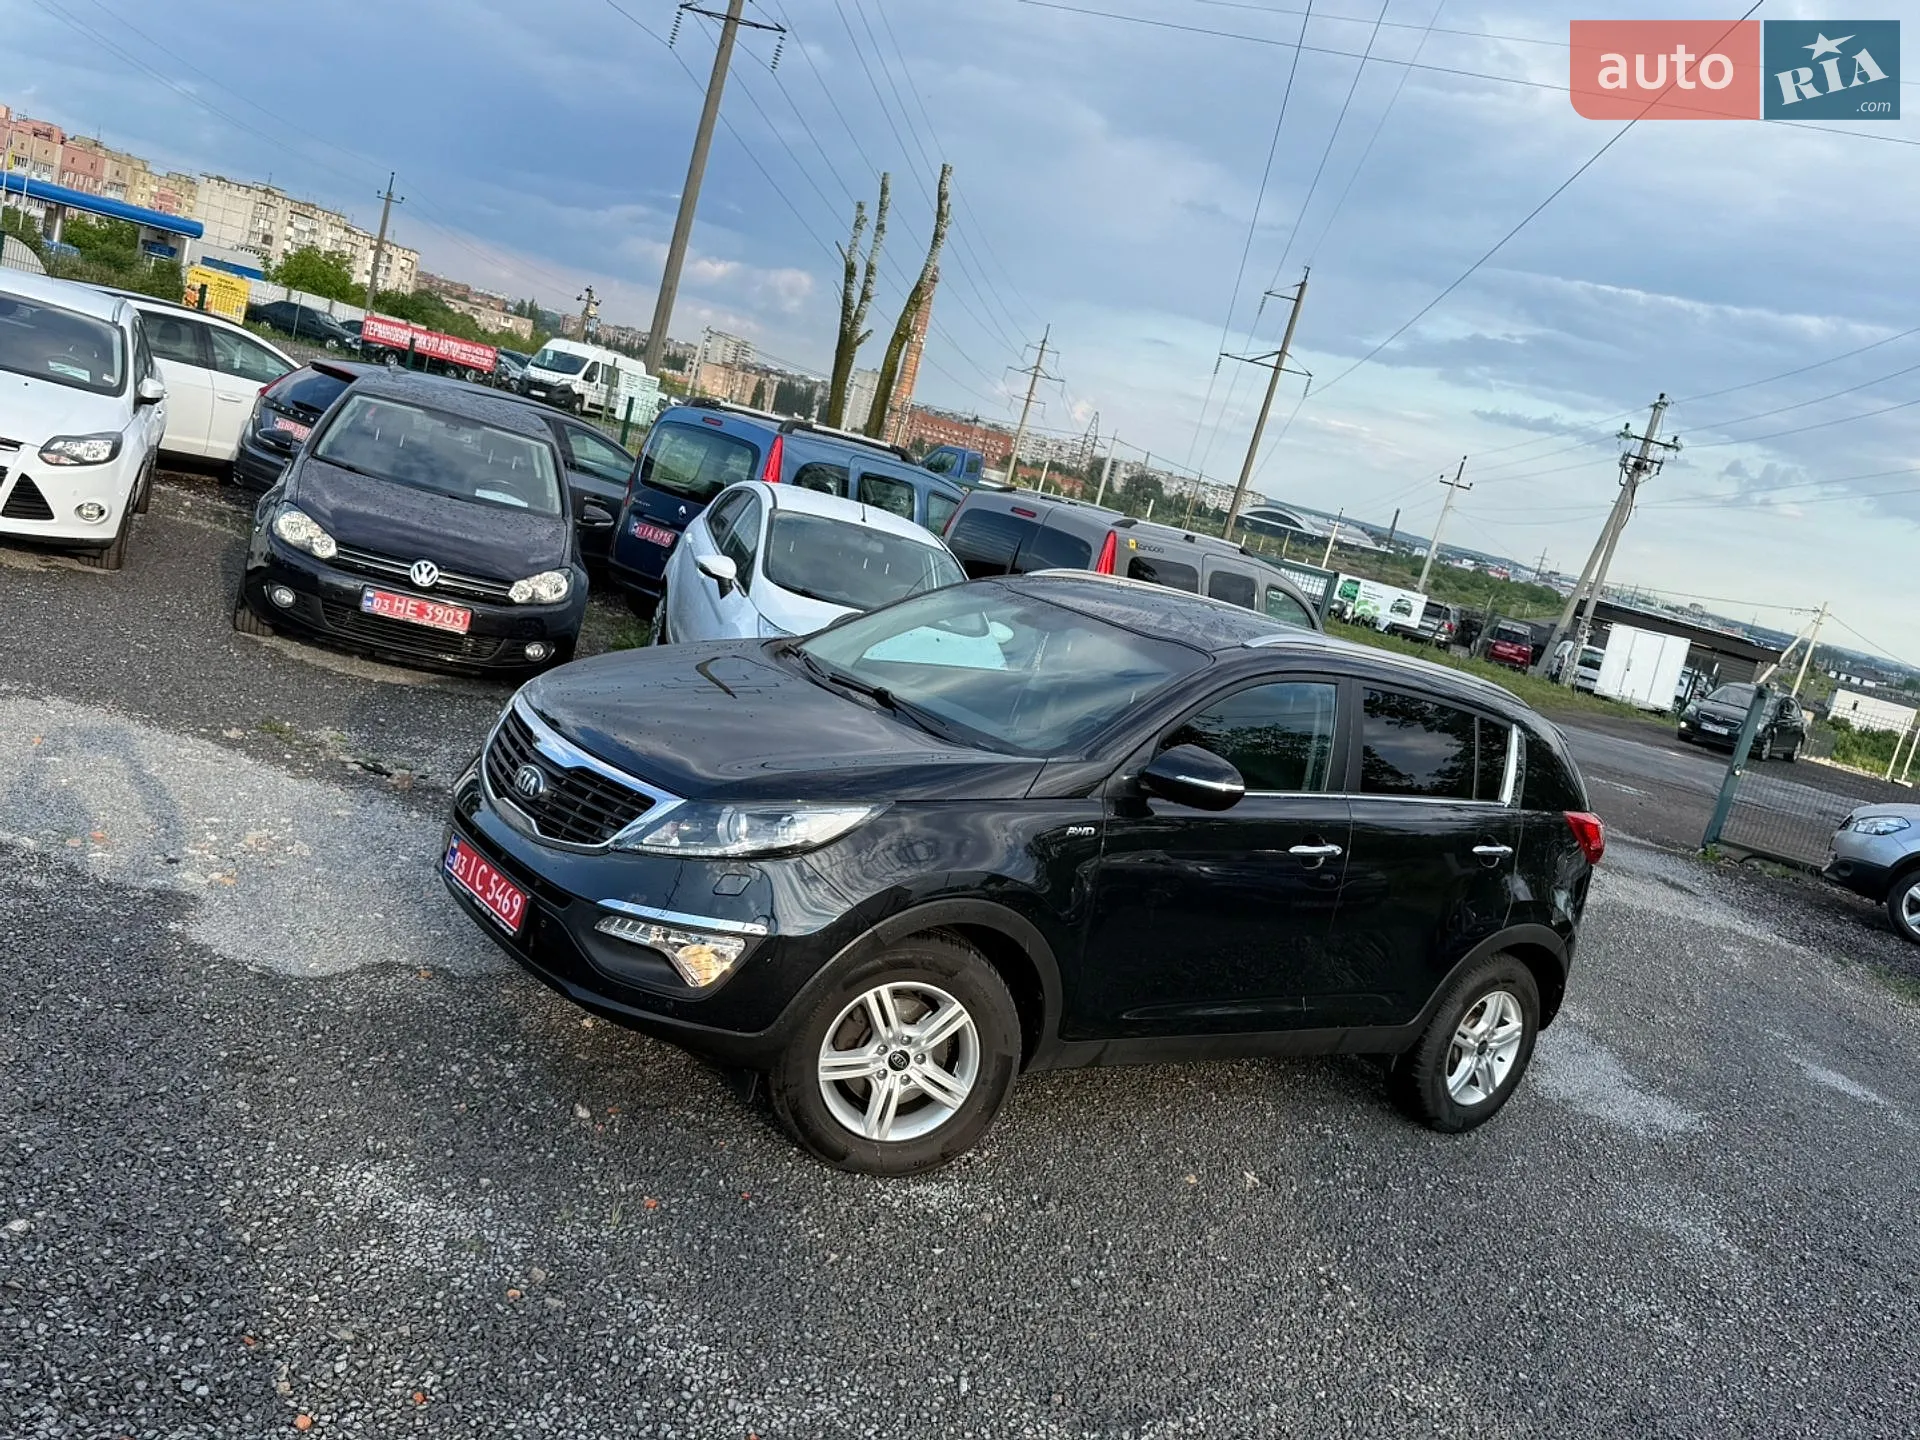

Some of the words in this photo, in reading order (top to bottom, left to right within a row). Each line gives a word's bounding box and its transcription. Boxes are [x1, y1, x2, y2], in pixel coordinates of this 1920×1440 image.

[373, 597, 390, 611] 03
[393, 598, 418, 617] HE
[423, 605, 465, 627] 3903
[517, 769, 537, 795] KIA
[1066, 826, 1095, 836] AWD
[452, 851, 467, 875] 03
[467, 856, 488, 891] IC
[486, 873, 521, 920] 5469
